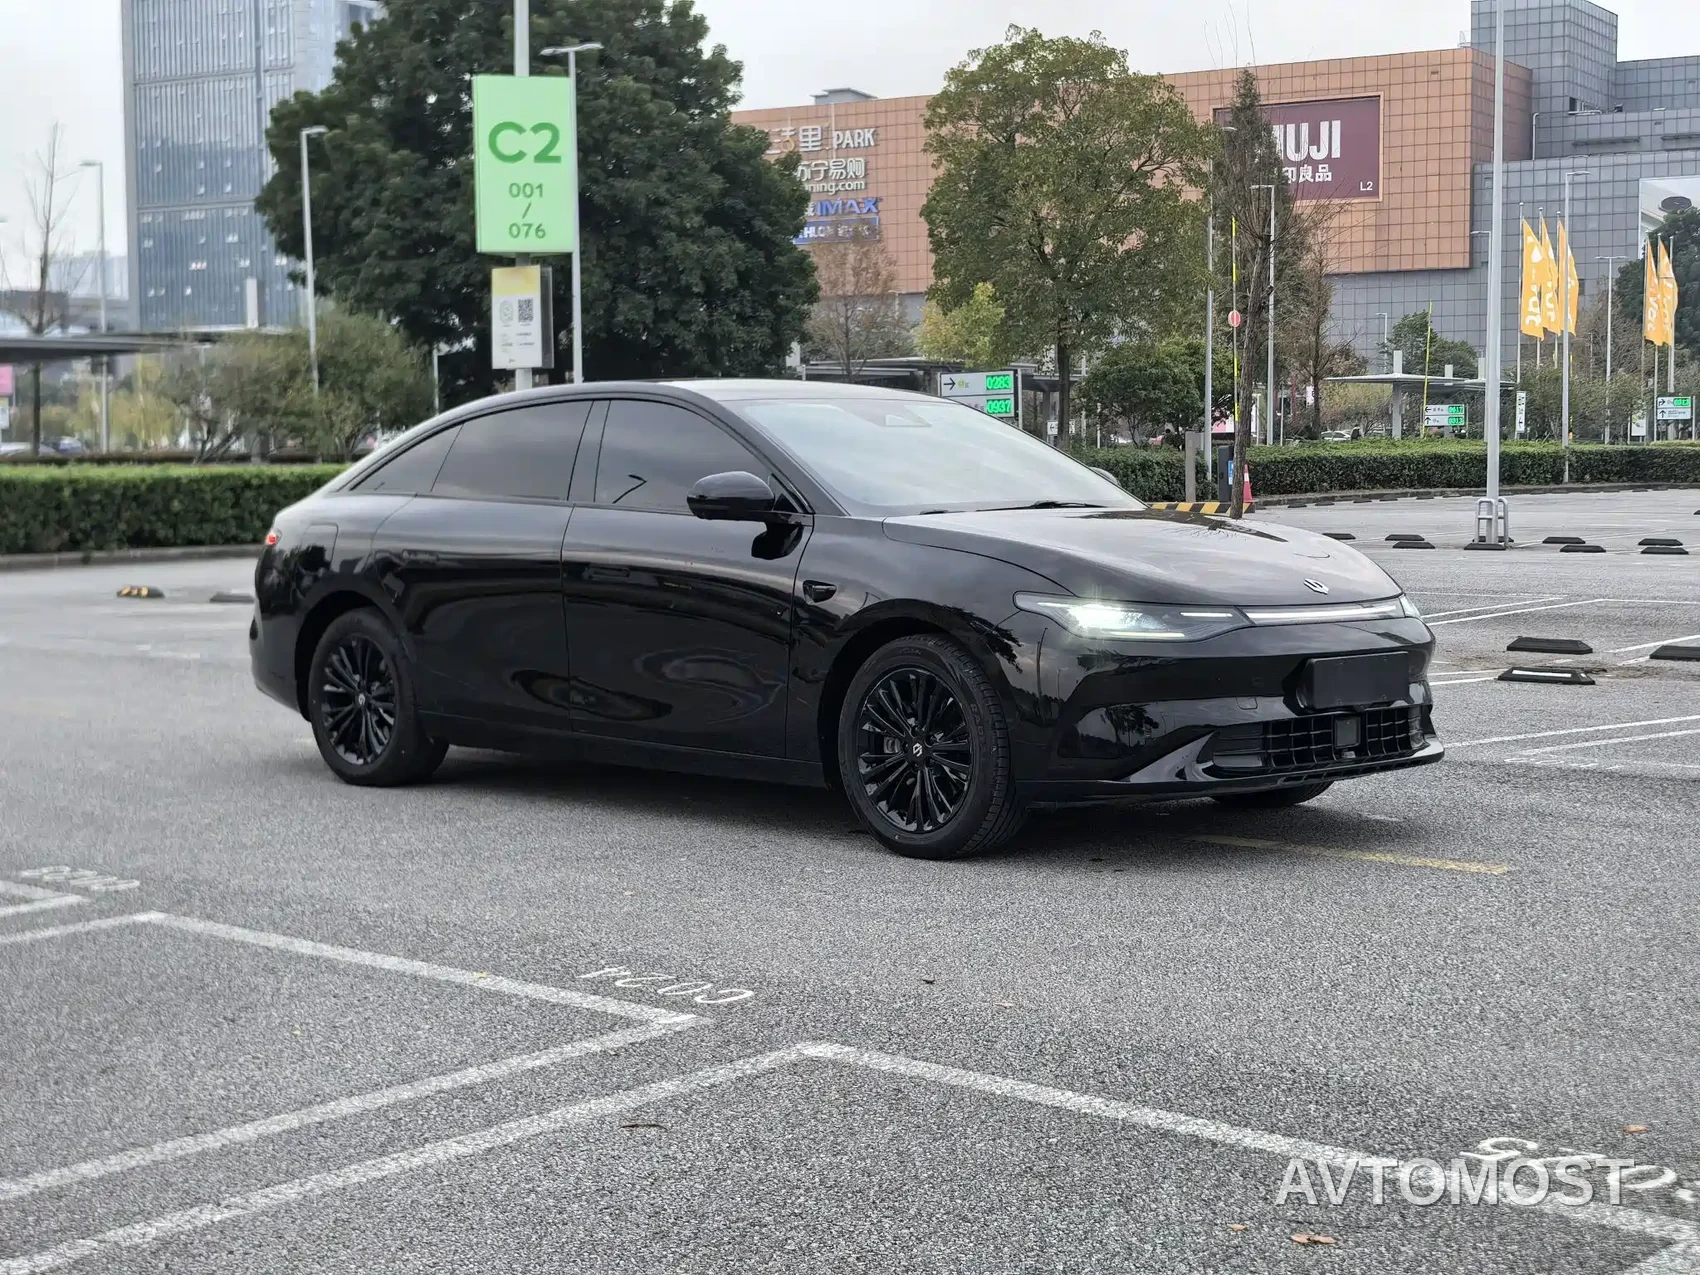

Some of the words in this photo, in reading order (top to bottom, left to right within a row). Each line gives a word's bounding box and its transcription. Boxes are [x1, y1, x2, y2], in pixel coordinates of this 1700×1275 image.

[487, 121, 562, 164] C2
[832, 128, 876, 149] PARK
[508, 182, 544, 199] 001
[1359, 181, 1373, 191] L2
[521, 202, 532, 219] /
[815, 197, 879, 217] IMAX
[508, 222, 546, 239] 076
[987, 375, 1011, 390] 0283
[987, 400, 1011, 414] 0937
